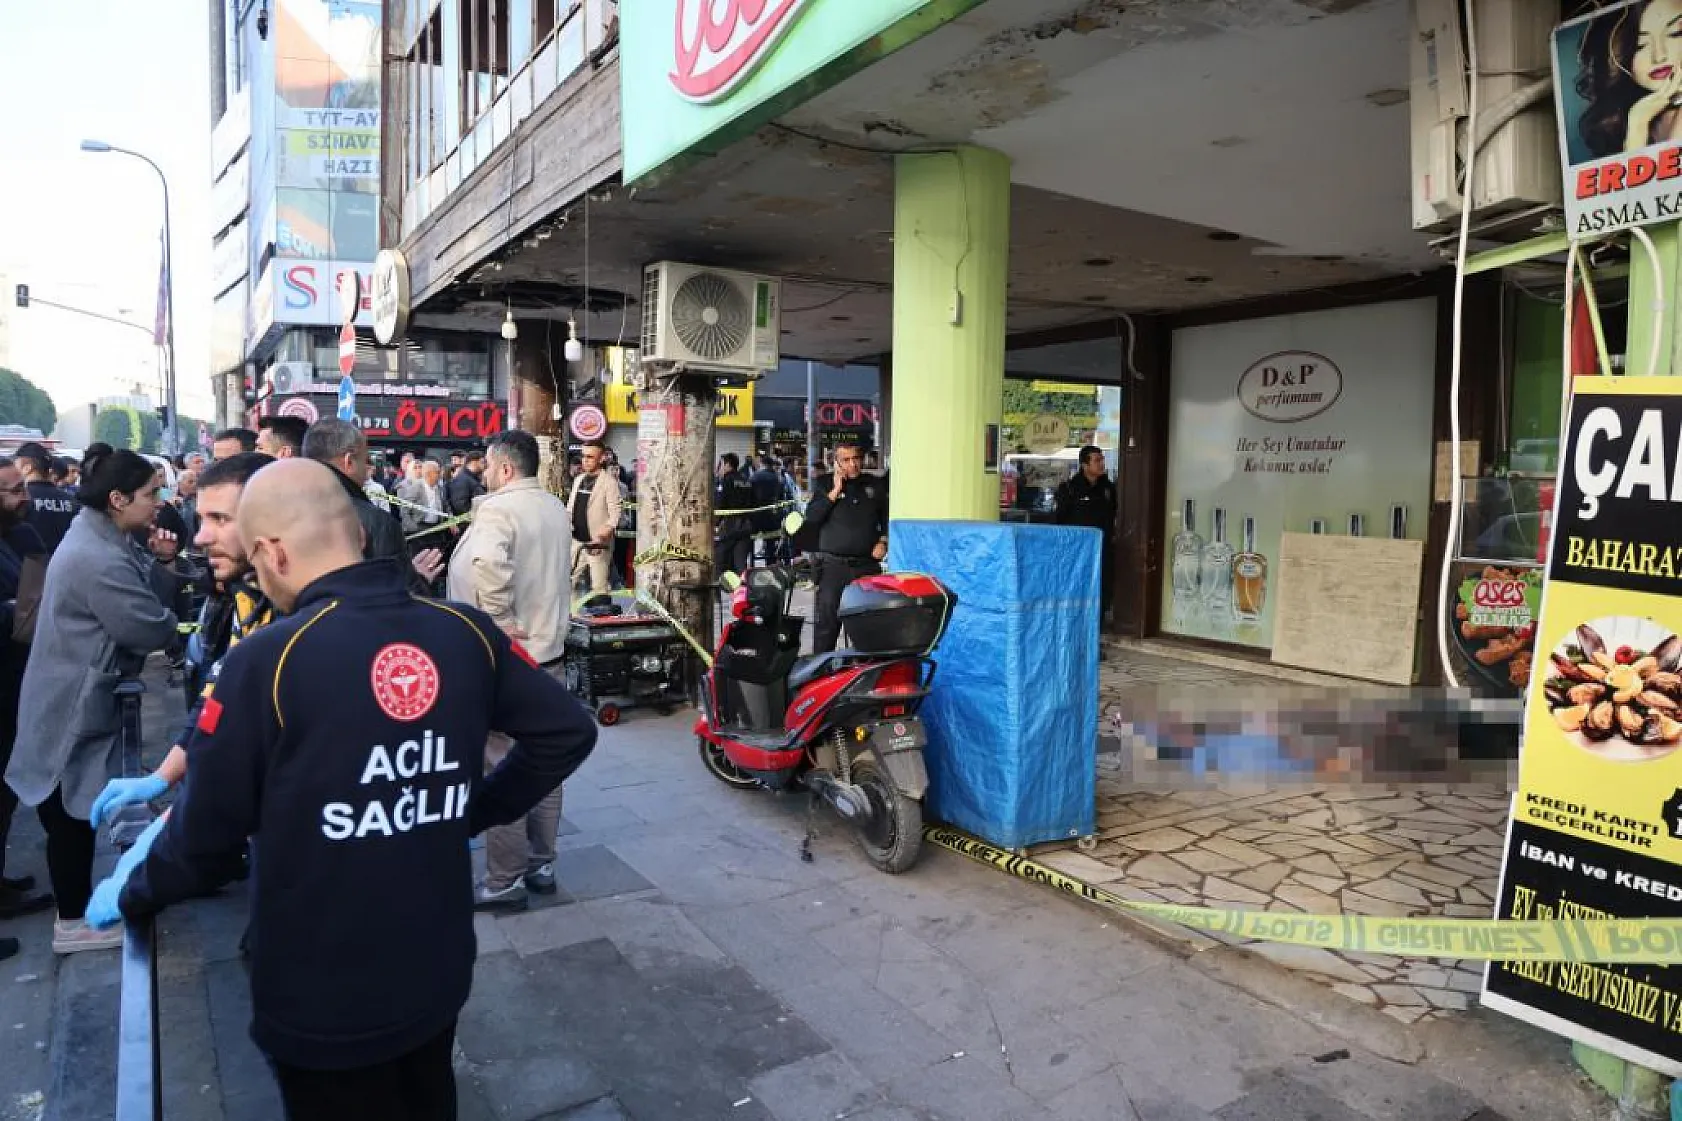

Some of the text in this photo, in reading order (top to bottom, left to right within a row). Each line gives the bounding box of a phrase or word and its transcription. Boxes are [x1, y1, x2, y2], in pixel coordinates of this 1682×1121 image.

[1577, 201, 1648, 232] ASMA
[1236, 437, 1258, 452] Her
[360, 729, 460, 784] ACİL
[1594, 809, 1660, 836] KARTI
[1520, 839, 1575, 872] İBAN
[1581, 862, 1607, 880] ve
